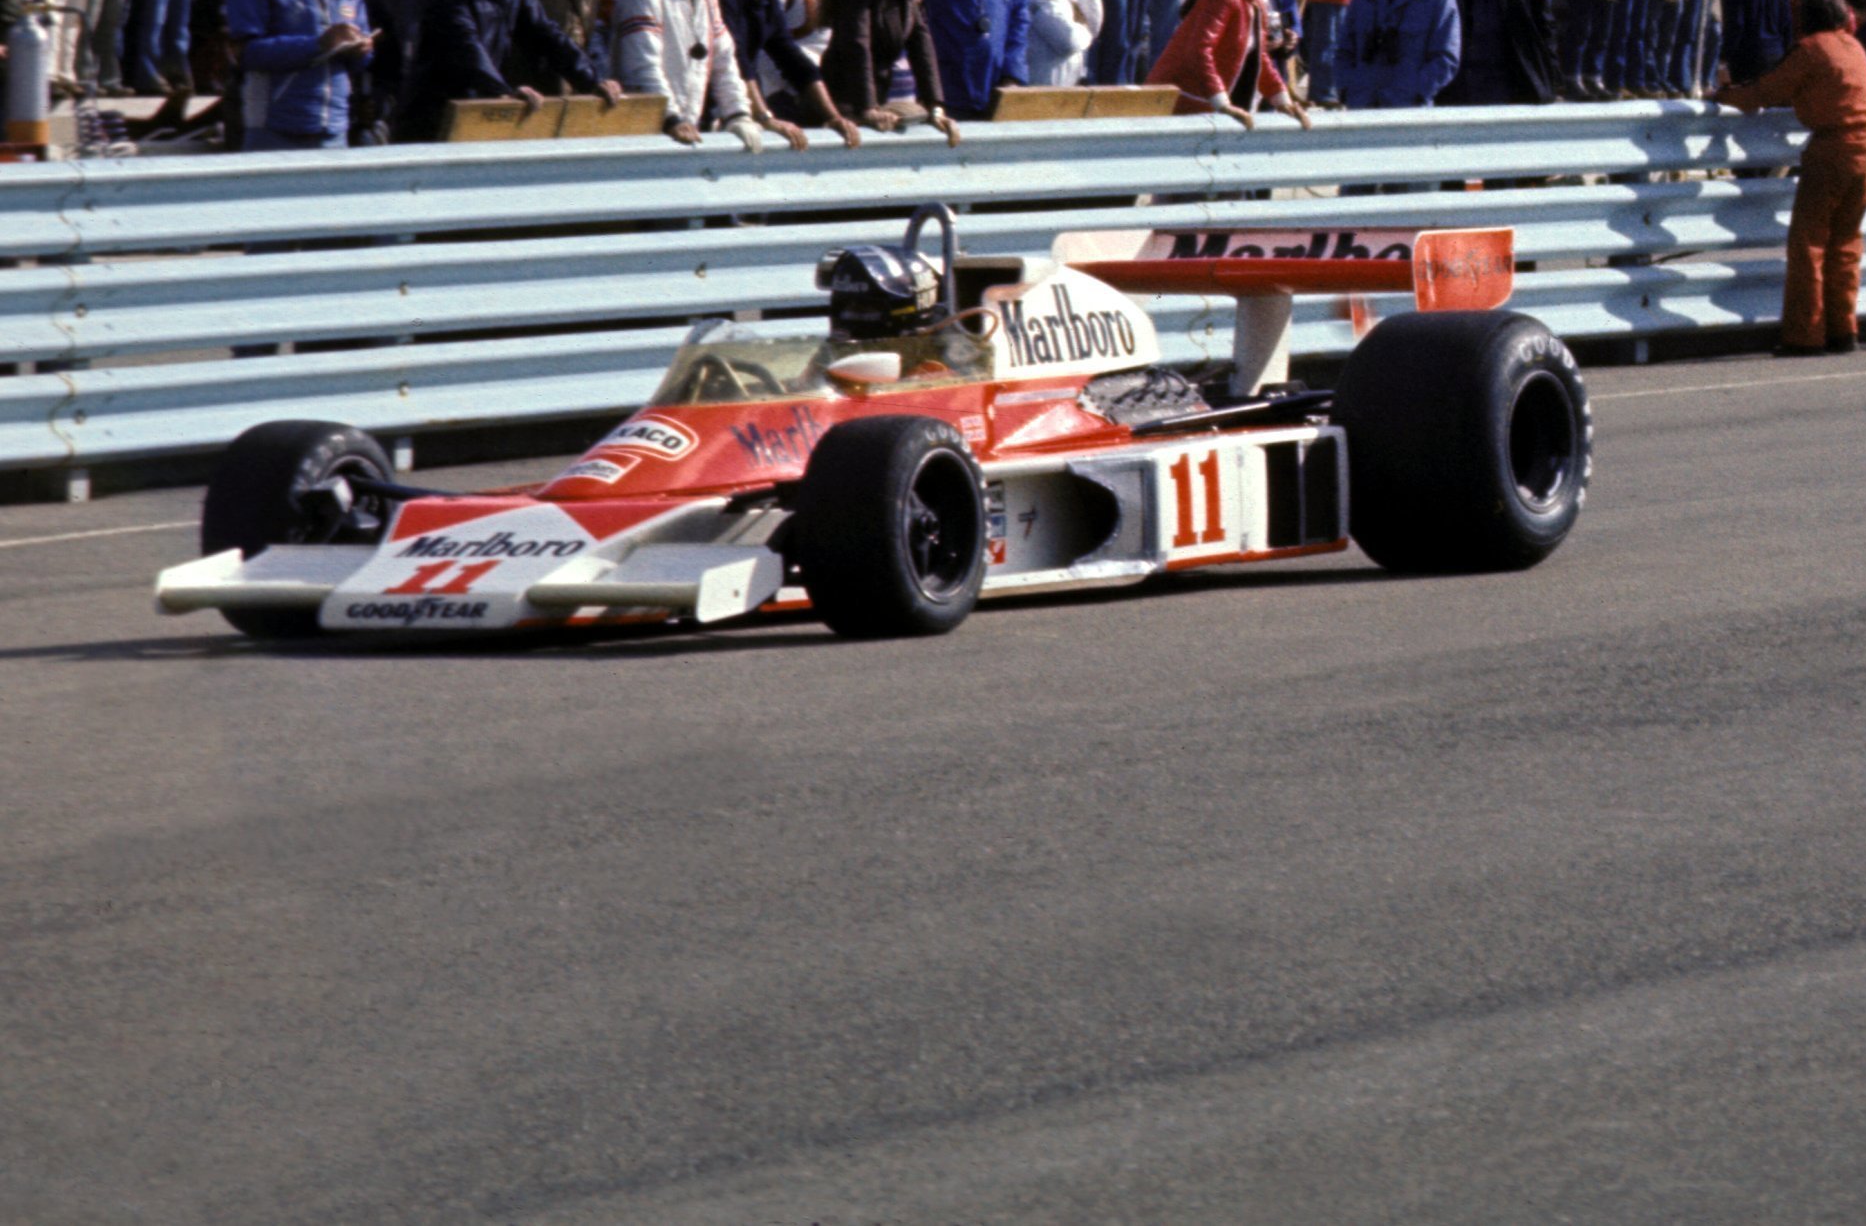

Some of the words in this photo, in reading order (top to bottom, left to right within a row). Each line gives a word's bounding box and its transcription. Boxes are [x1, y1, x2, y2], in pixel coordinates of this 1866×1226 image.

[998, 284, 1136, 368] Marlboro
[1170, 449, 1226, 548] 11
[400, 531, 587, 558] Marlboro
[382, 559, 503, 595] 11
[347, 600, 488, 621] GOODYEAR
